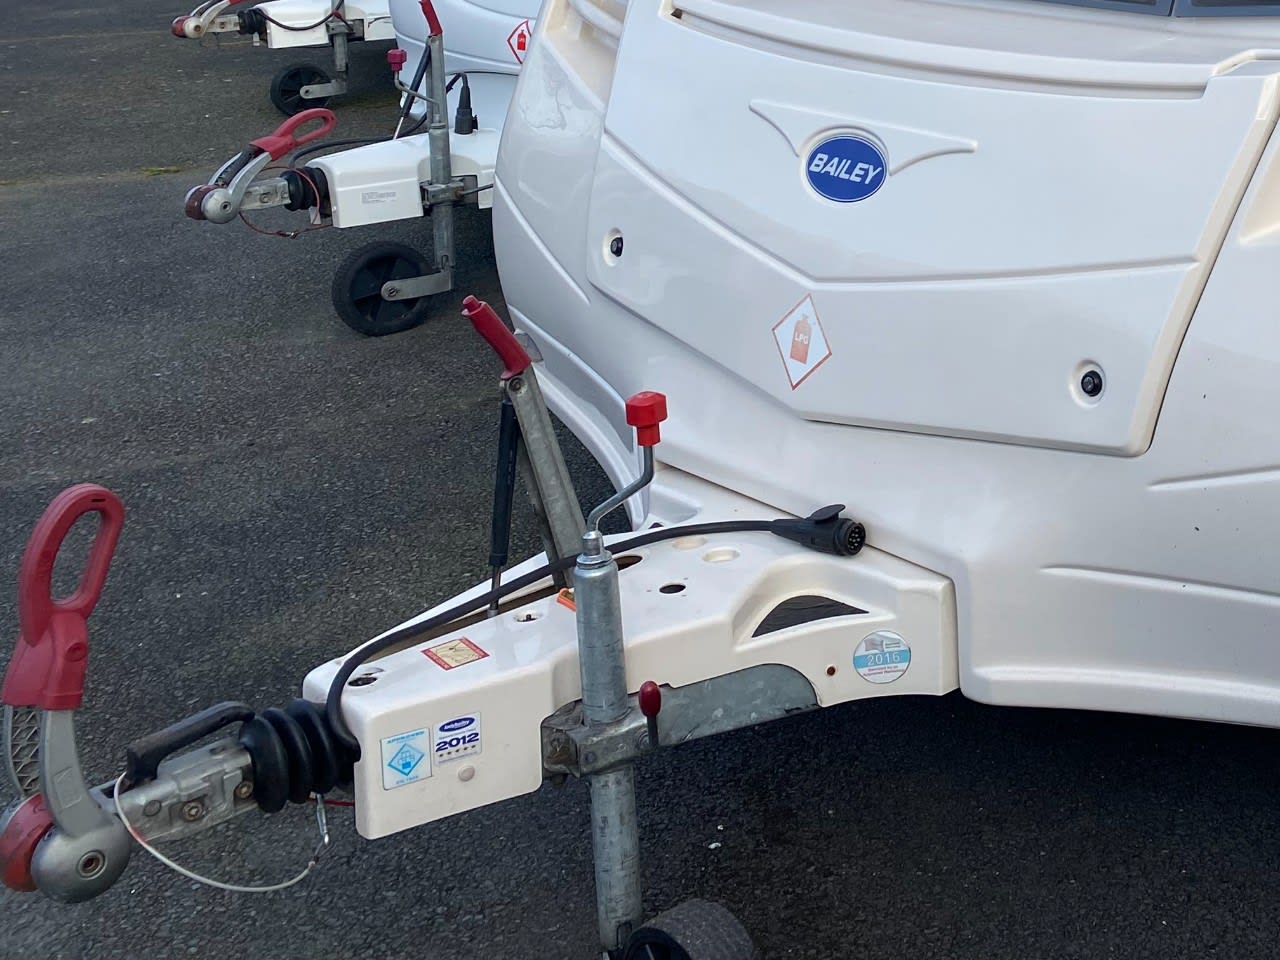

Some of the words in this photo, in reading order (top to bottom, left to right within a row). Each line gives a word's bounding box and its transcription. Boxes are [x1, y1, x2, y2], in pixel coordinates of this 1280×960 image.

[808, 152, 883, 185] BAILEY
[794, 331, 810, 345] LPG
[867, 651, 901, 667] 2016
[435, 732, 480, 752] 2012
